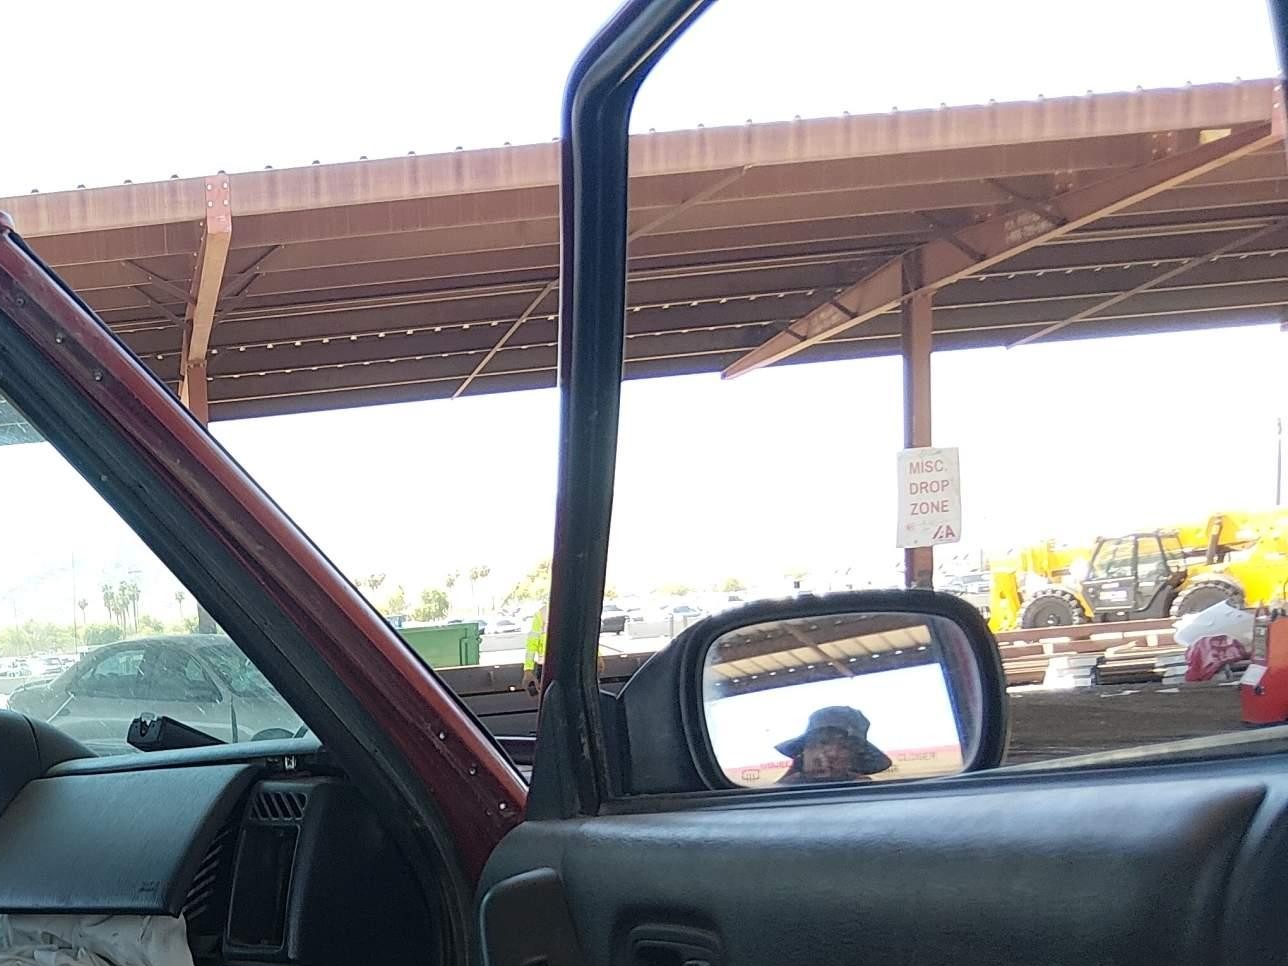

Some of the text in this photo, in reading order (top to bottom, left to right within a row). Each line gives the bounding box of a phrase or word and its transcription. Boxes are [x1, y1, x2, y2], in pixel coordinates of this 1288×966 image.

[909, 459, 949, 475] MISC.
[909, 480, 950, 496] DROP
[910, 500, 950, 516] ZONE
